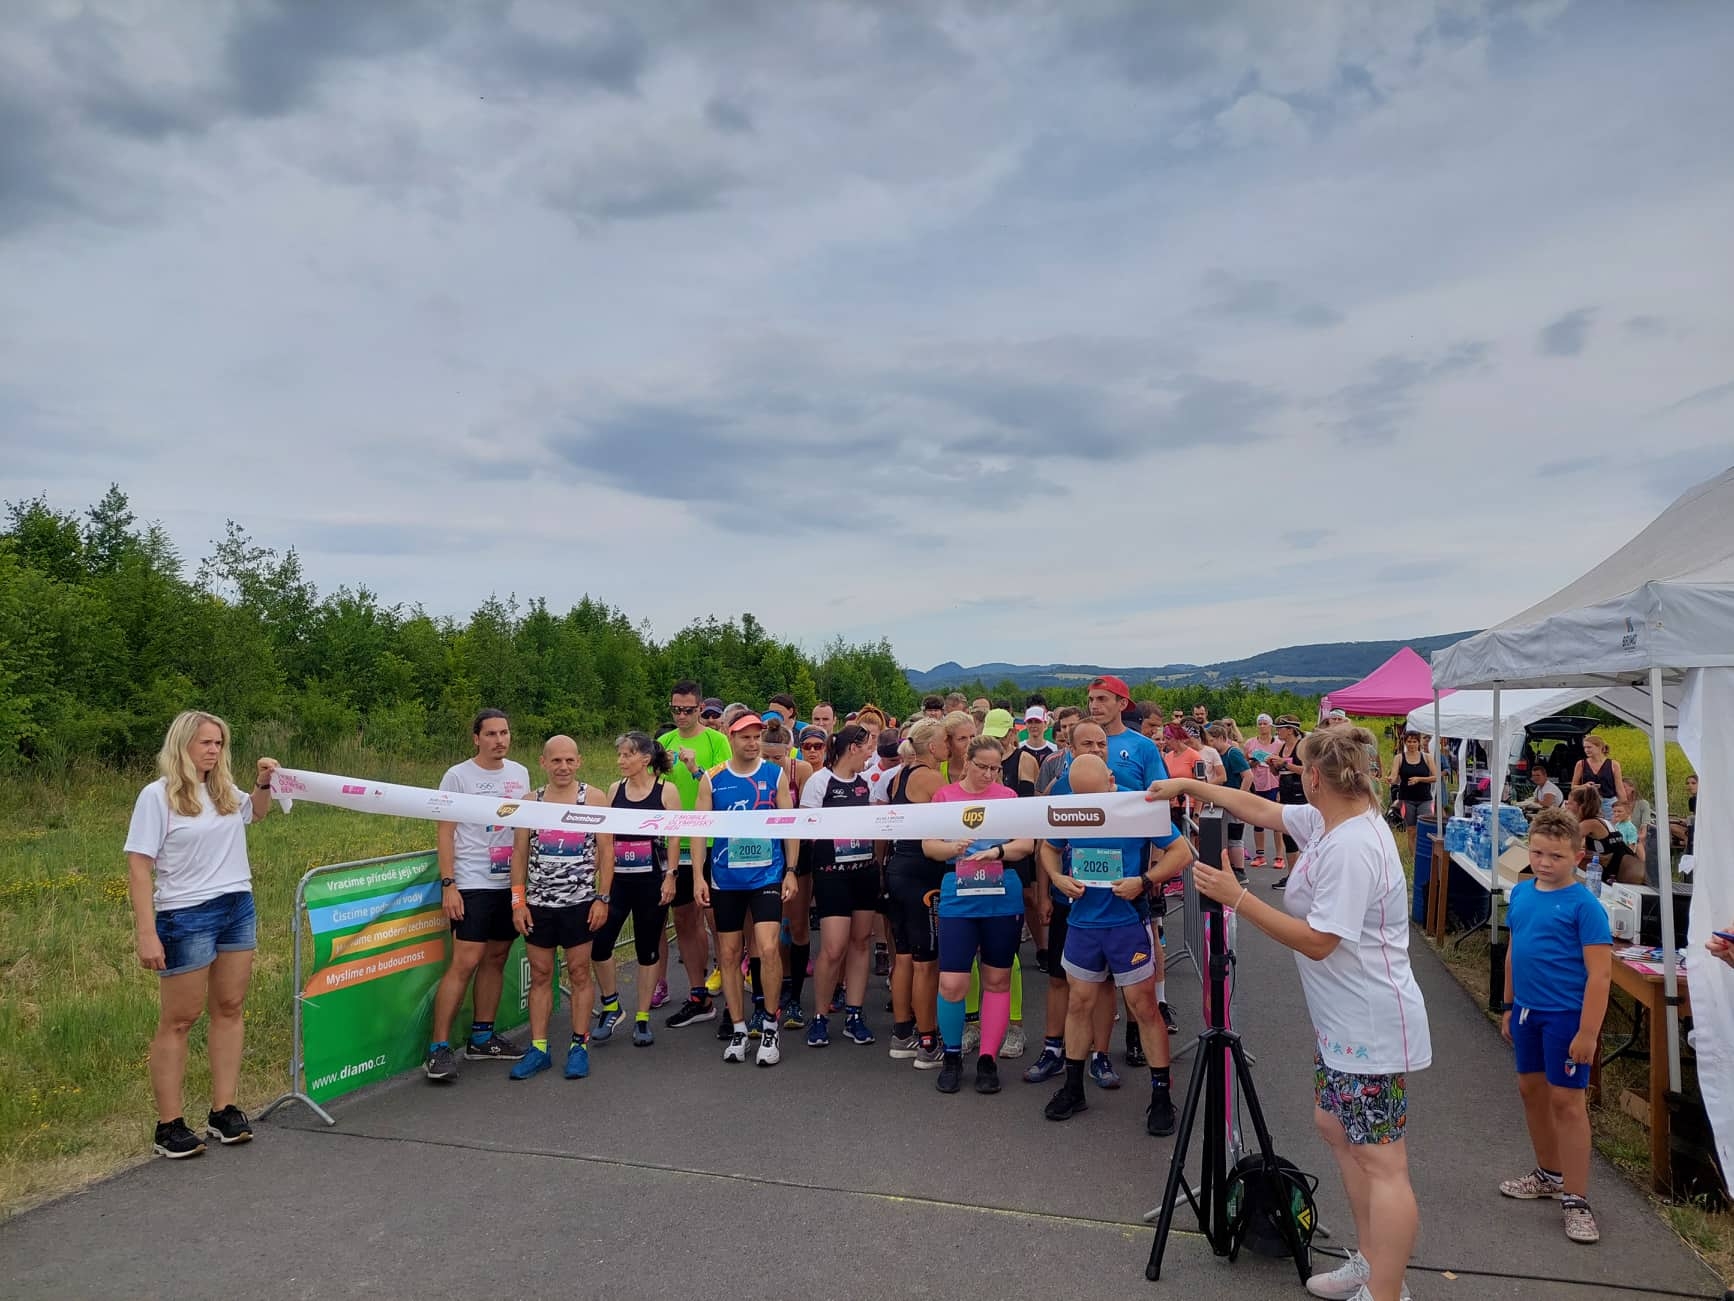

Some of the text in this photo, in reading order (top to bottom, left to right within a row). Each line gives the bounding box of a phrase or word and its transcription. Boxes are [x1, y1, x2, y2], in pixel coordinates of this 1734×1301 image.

[963, 811, 984, 826] ups
[1053, 811, 1100, 822] bombus
[558, 838, 565, 849] 7
[740, 845, 762, 855] 2002
[624, 851, 636, 861] 69
[1083, 861, 1109, 873] 2026
[327, 876, 366, 891] Vracíme
[366, 870, 397, 887] přírodě
[399, 866, 412, 880] její
[332, 906, 369, 923] Čistíme
[402, 891, 423, 905] vody
[326, 951, 425, 986] Myslíme na budoucnost
[312, 1054, 386, 1091] www.diamo.cz
